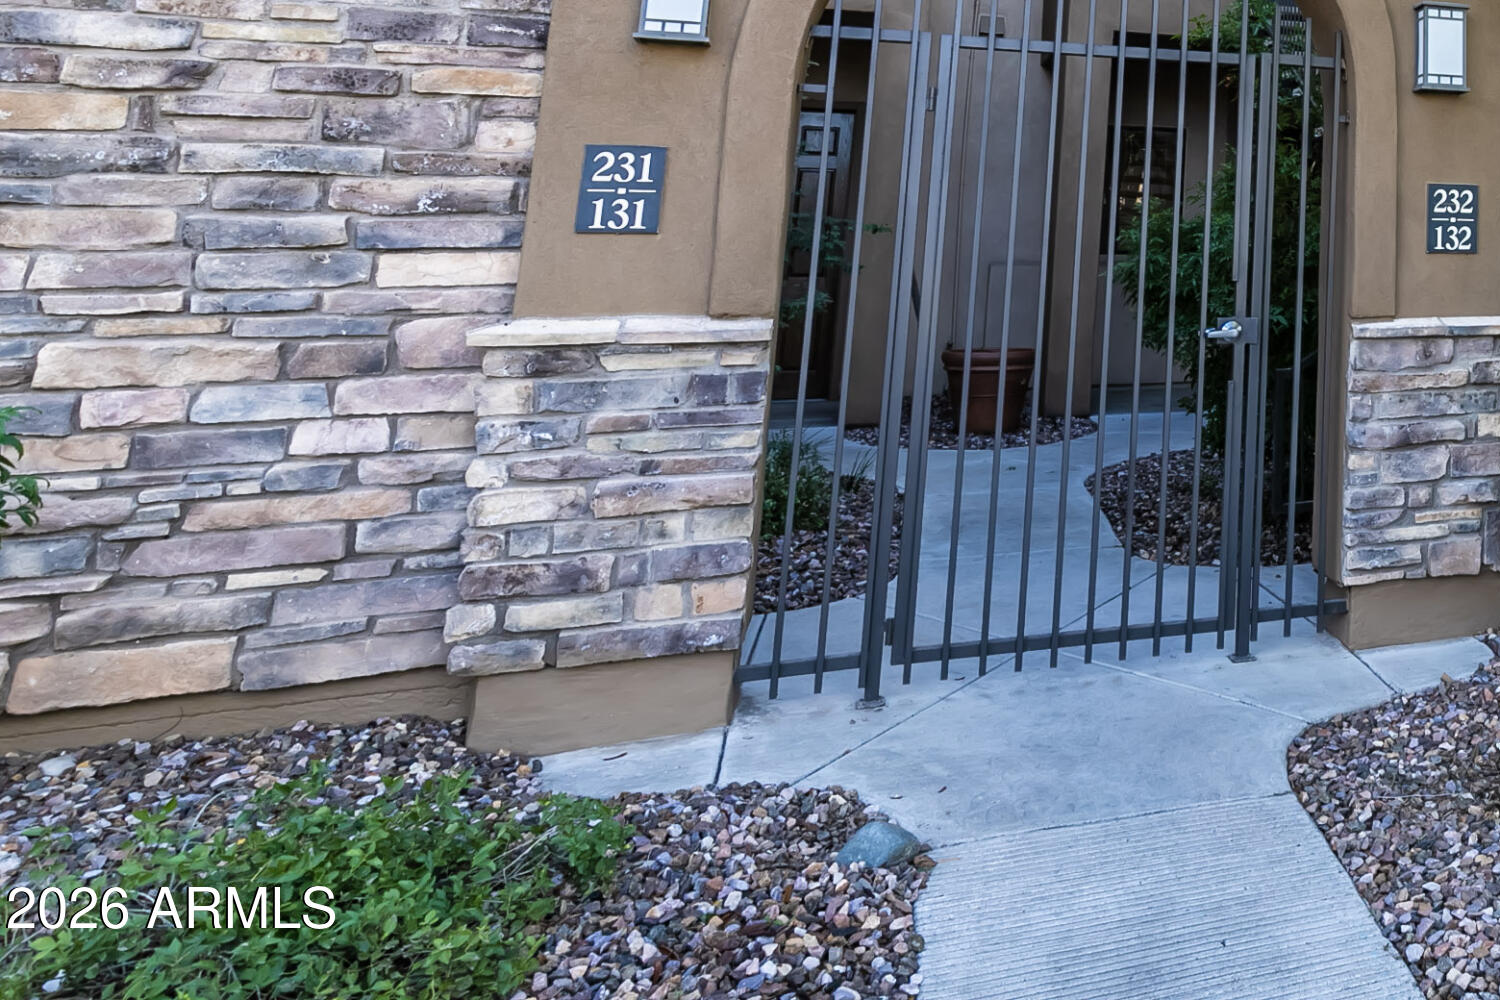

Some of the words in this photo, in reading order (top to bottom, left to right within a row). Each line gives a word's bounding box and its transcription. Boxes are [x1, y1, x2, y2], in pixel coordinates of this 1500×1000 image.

[591, 151, 654, 183] 231
[588, 198, 647, 230] 131
[1433, 188, 1474, 214] 232
[1434, 225, 1472, 251] 132
